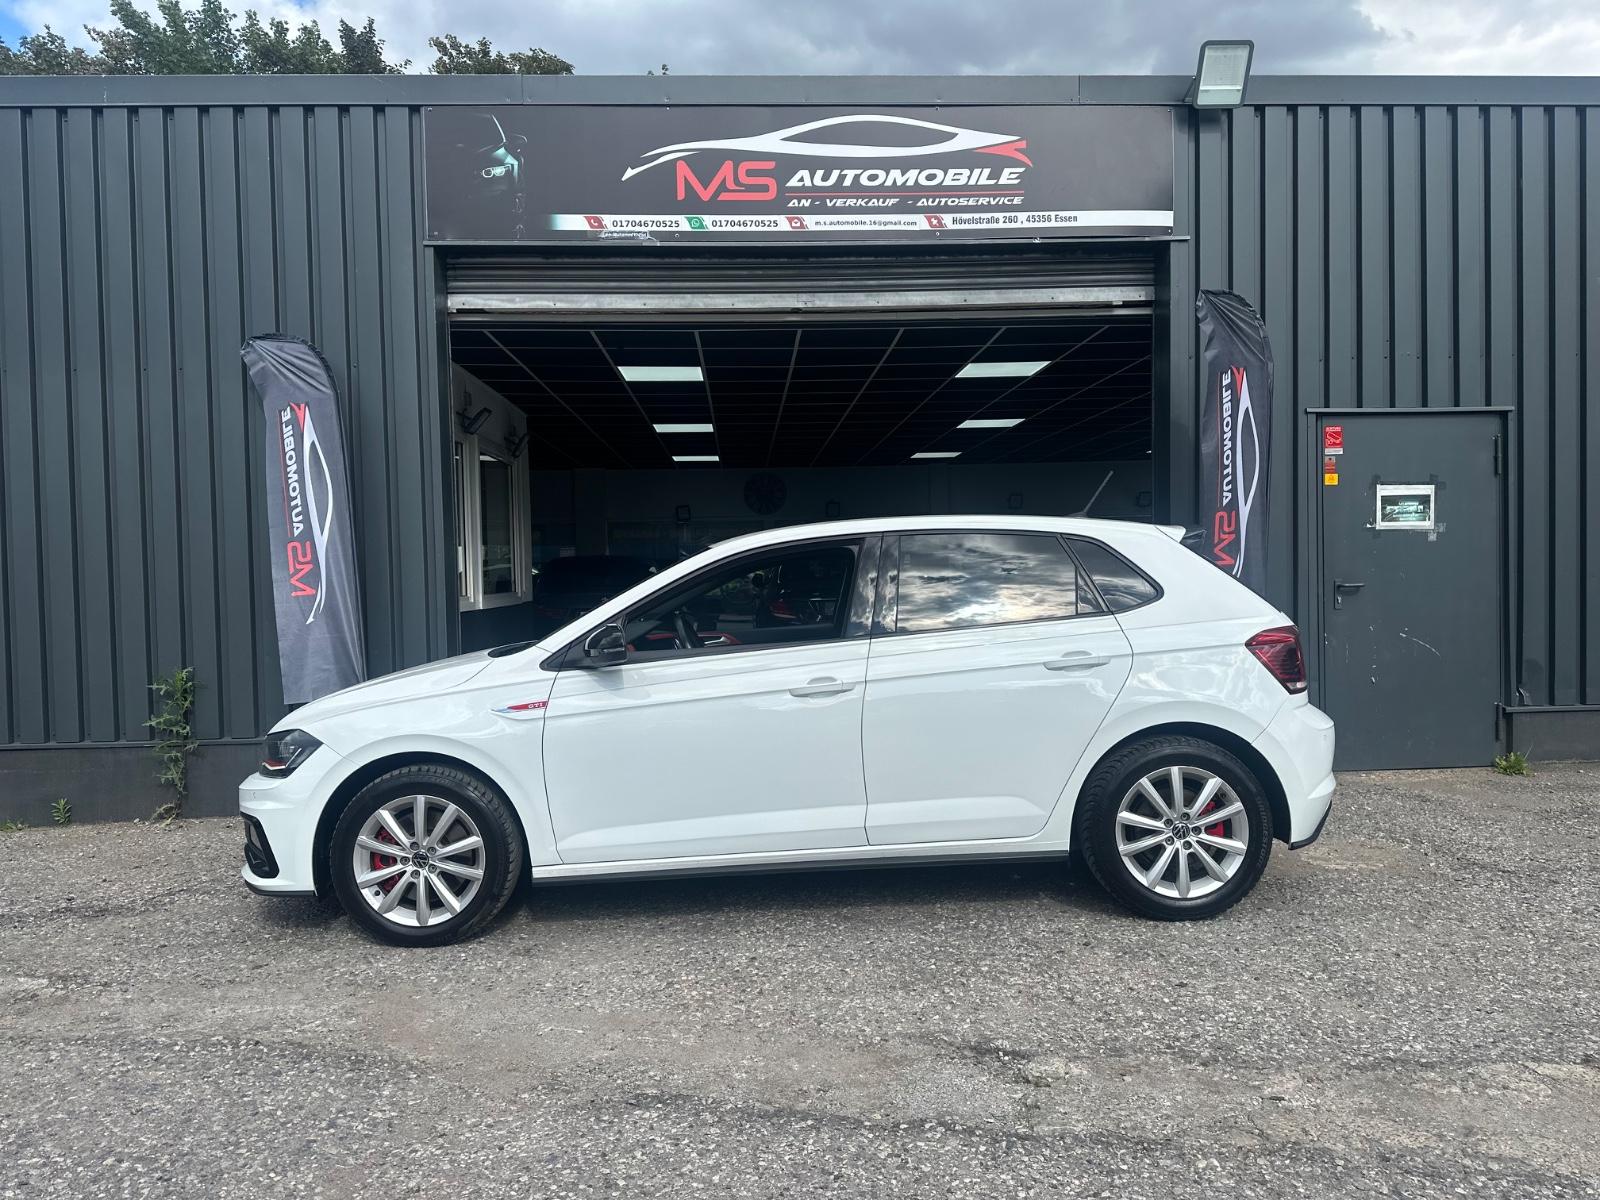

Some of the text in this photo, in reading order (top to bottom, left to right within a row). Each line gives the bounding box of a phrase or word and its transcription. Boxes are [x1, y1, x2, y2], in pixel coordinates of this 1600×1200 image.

[676, 159, 1026, 202] MS AUTOMOBILE
[787, 198, 811, 207] AN
[826, 198, 900, 207] VERKAUF
[916, 196, 1025, 207] AUTOSERVICE
[612, 219, 680, 228] 01704670525
[712, 219, 779, 228] 01704670525
[952, 215, 1000, 225] Hövelstraße
[1002, 215, 1018, 224] 260
[1026, 214, 1052, 223] 45356
[1054, 213, 1078, 223] Essen
